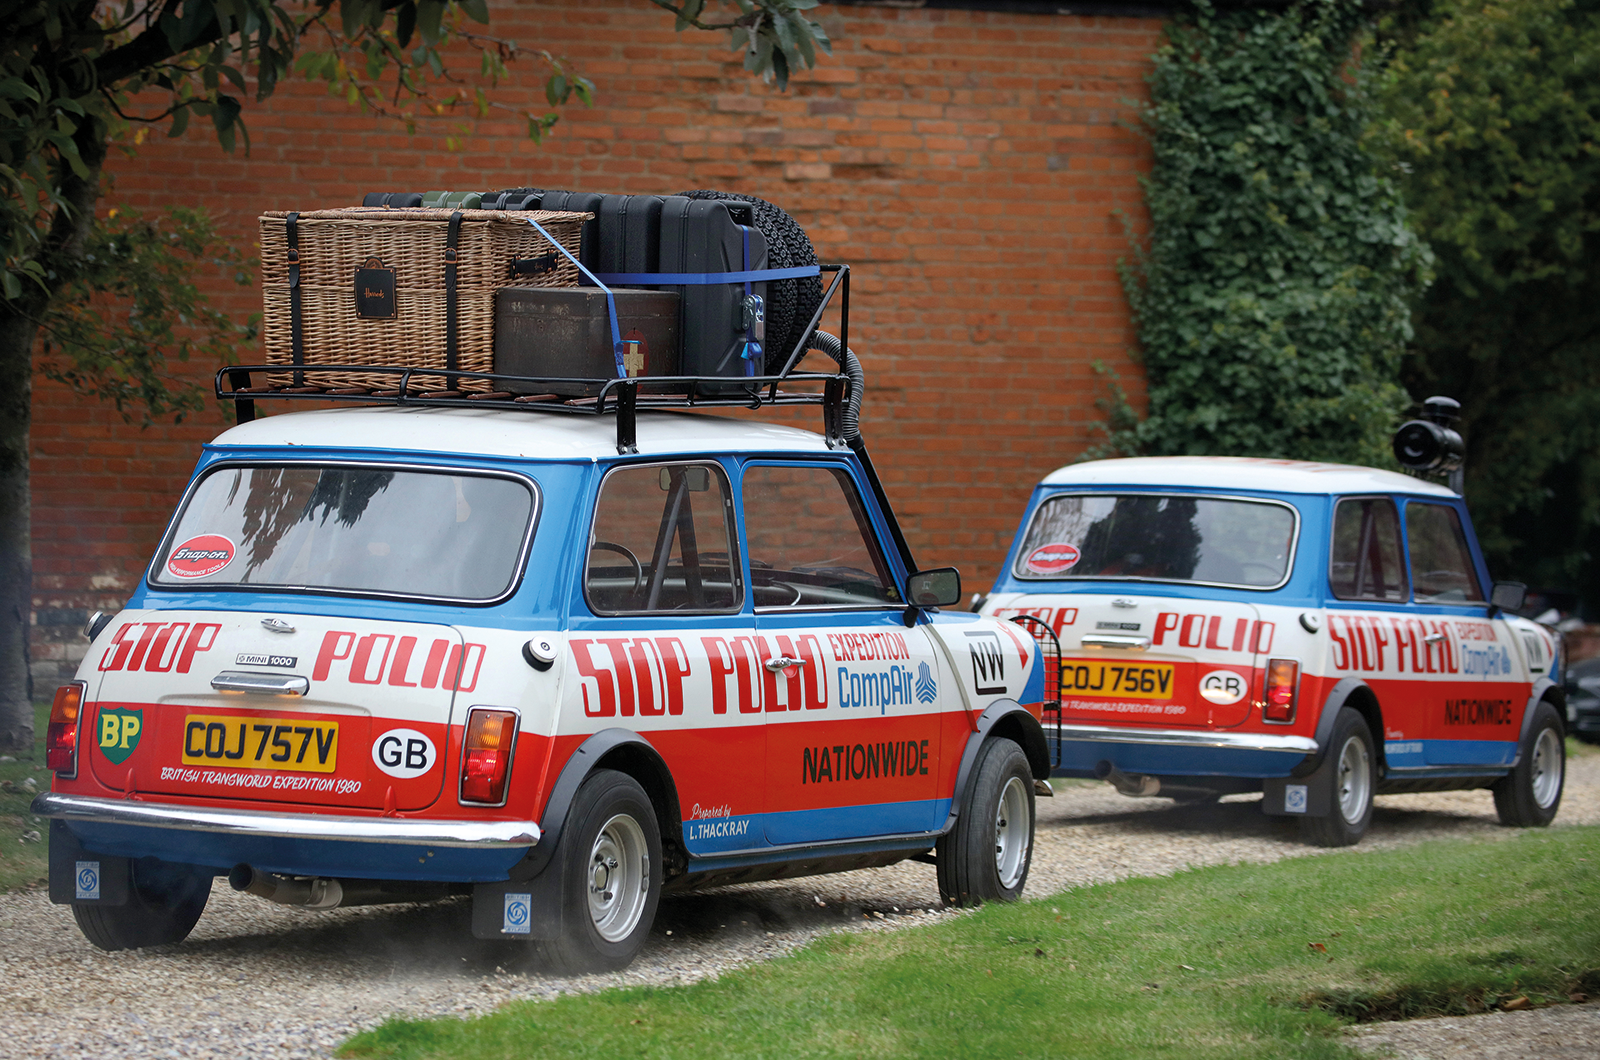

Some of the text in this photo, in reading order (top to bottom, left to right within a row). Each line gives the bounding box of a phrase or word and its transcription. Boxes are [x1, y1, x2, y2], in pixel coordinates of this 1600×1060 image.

[1152, 612, 1275, 655] POLIO
[1327, 614, 1388, 672] STOP
[1389, 617, 1459, 674] POLIO
[97, 622, 487, 693] STOP POLIO
[246, 655, 293, 666] MINI 1000
[568, 632, 910, 717] STOP POLIO EXPEDITION
[969, 641, 1004, 682] NW
[837, 664, 914, 715] CompAir
[1060, 665, 1172, 694] COJ 756V
[1204, 676, 1241, 698] GB
[1445, 699, 1512, 725] NATIONWIDE
[99, 714, 141, 749] BP
[184, 721, 336, 765] COJ 757V
[378, 736, 429, 770] GB
[802, 739, 929, 784] NATIONWIDE
[160, 767, 362, 794] BRITISH TRANSWORLD EXPEDITION 1980
[723, 804, 732, 820] by
